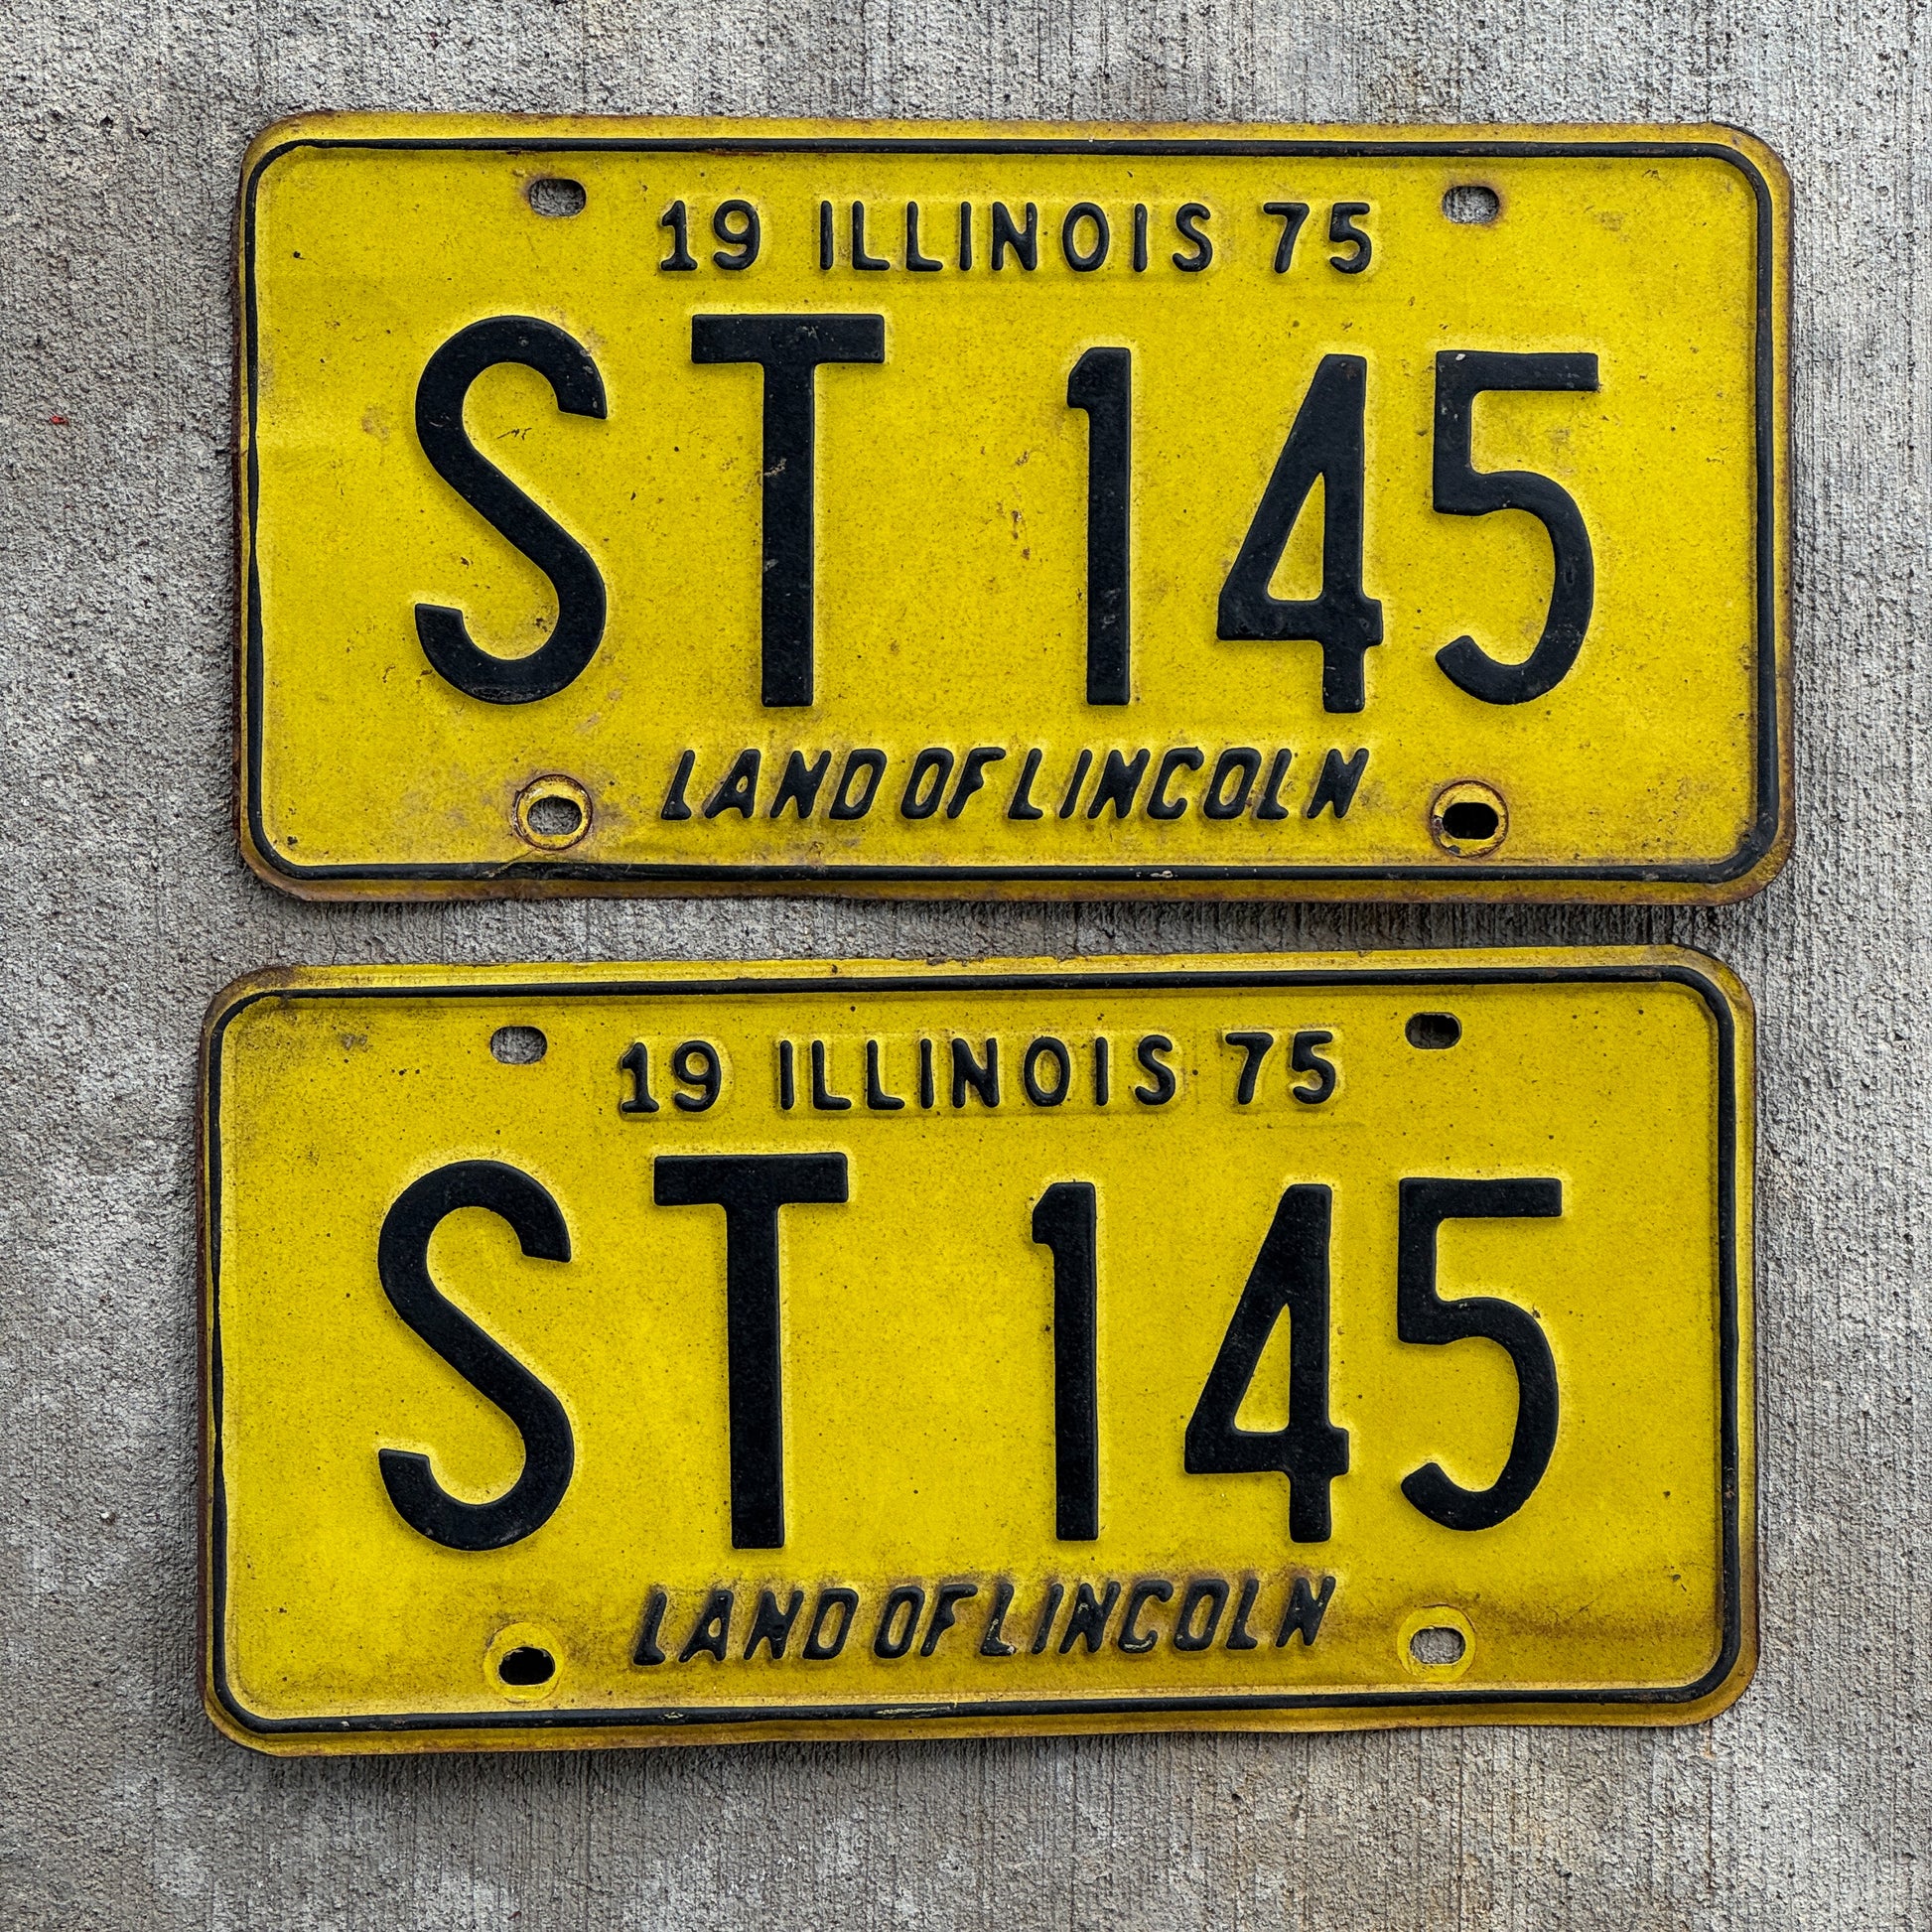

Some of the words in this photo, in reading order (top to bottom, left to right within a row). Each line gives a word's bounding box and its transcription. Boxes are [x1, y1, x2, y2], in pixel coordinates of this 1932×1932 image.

[658, 200, 760, 273] 19
[820, 201, 1213, 273] ILLINOIS
[1264, 202, 1372, 275] 75
[415, 314, 885, 708] ST
[1067, 347, 1598, 714] 145
[661, 749, 888, 821] LAND
[900, 748, 1007, 820] OF
[1008, 747, 1370, 821] LINCOLN
[618, 1039, 722, 1116] 19
[780, 1035, 1176, 1111] ILLINOIS
[1224, 1031, 1336, 1106] 75
[377, 1152, 848, 1551] ST
[1031, 1177, 1562, 1543] 145
[632, 1586, 860, 1667] LAND
[874, 1583, 979, 1660] OF
[979, 1577, 1336, 1658] LINCOLN
